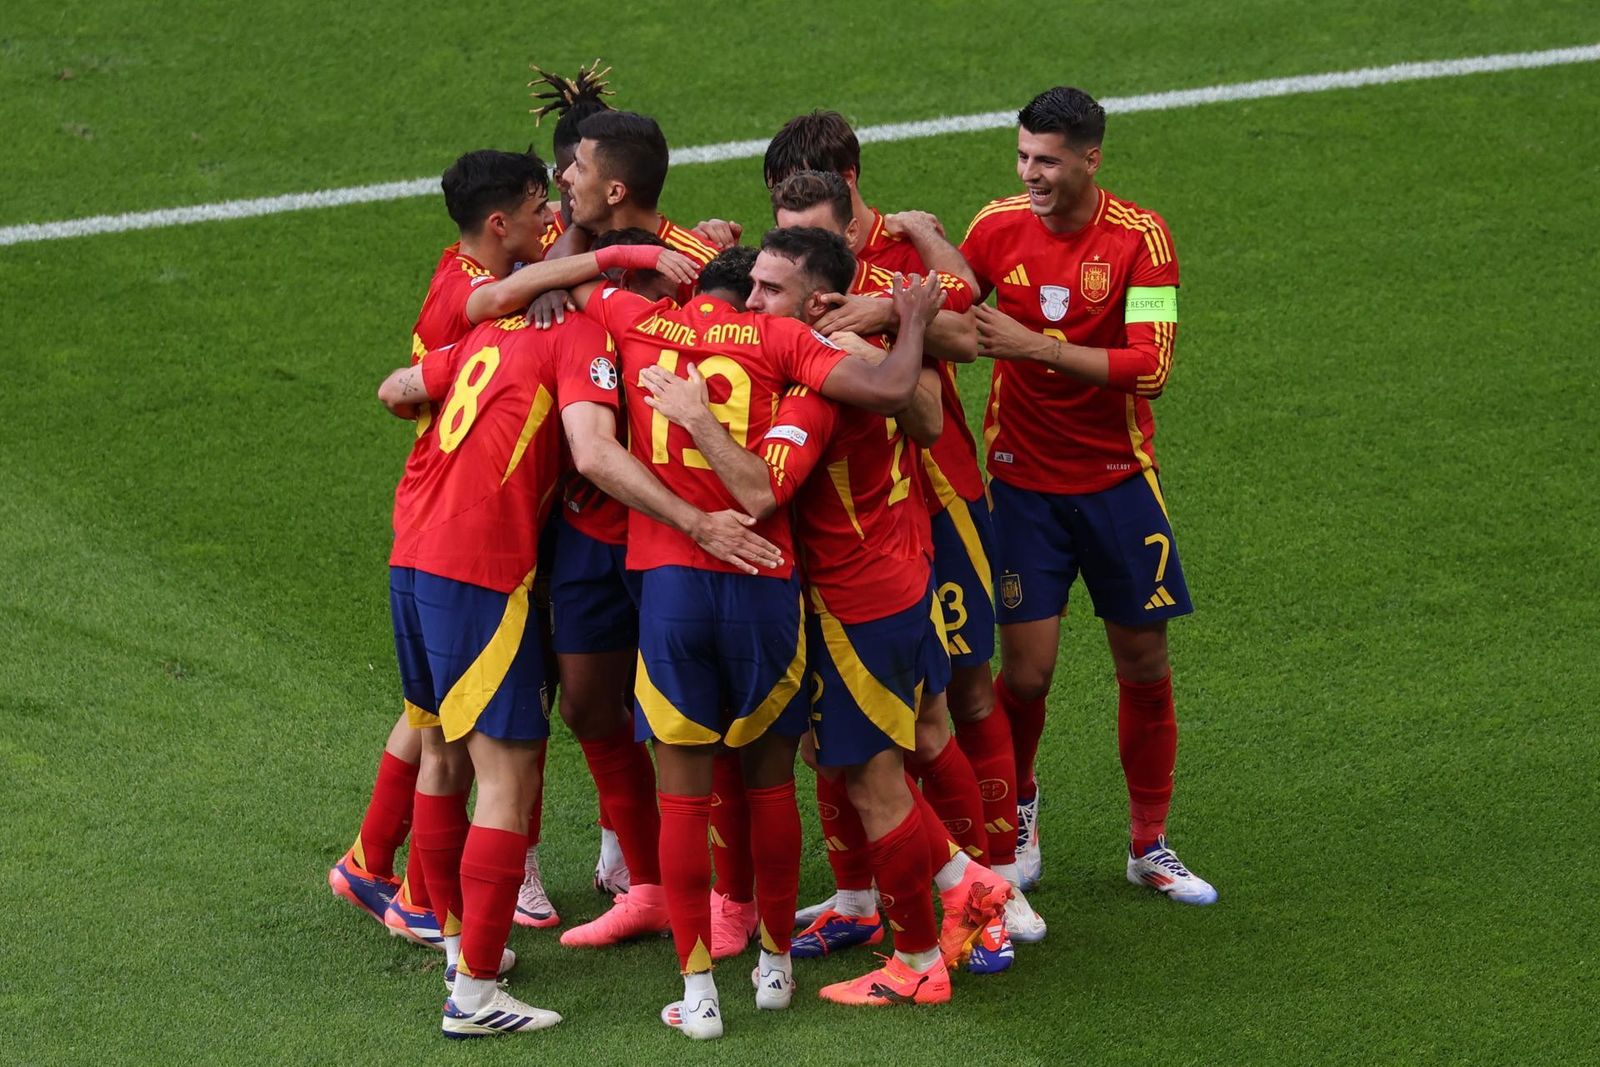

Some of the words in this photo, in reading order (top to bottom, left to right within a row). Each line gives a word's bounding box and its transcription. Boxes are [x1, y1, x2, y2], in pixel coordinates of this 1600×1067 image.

[1130, 300, 1164, 309] RESPECT
[636, 314, 697, 347] LAMINE
[703, 323, 760, 345] AMAL
[439, 345, 500, 455] 8
[637, 349, 752, 471] 19
[1144, 532, 1170, 582] 7
[938, 581, 968, 632] 3
